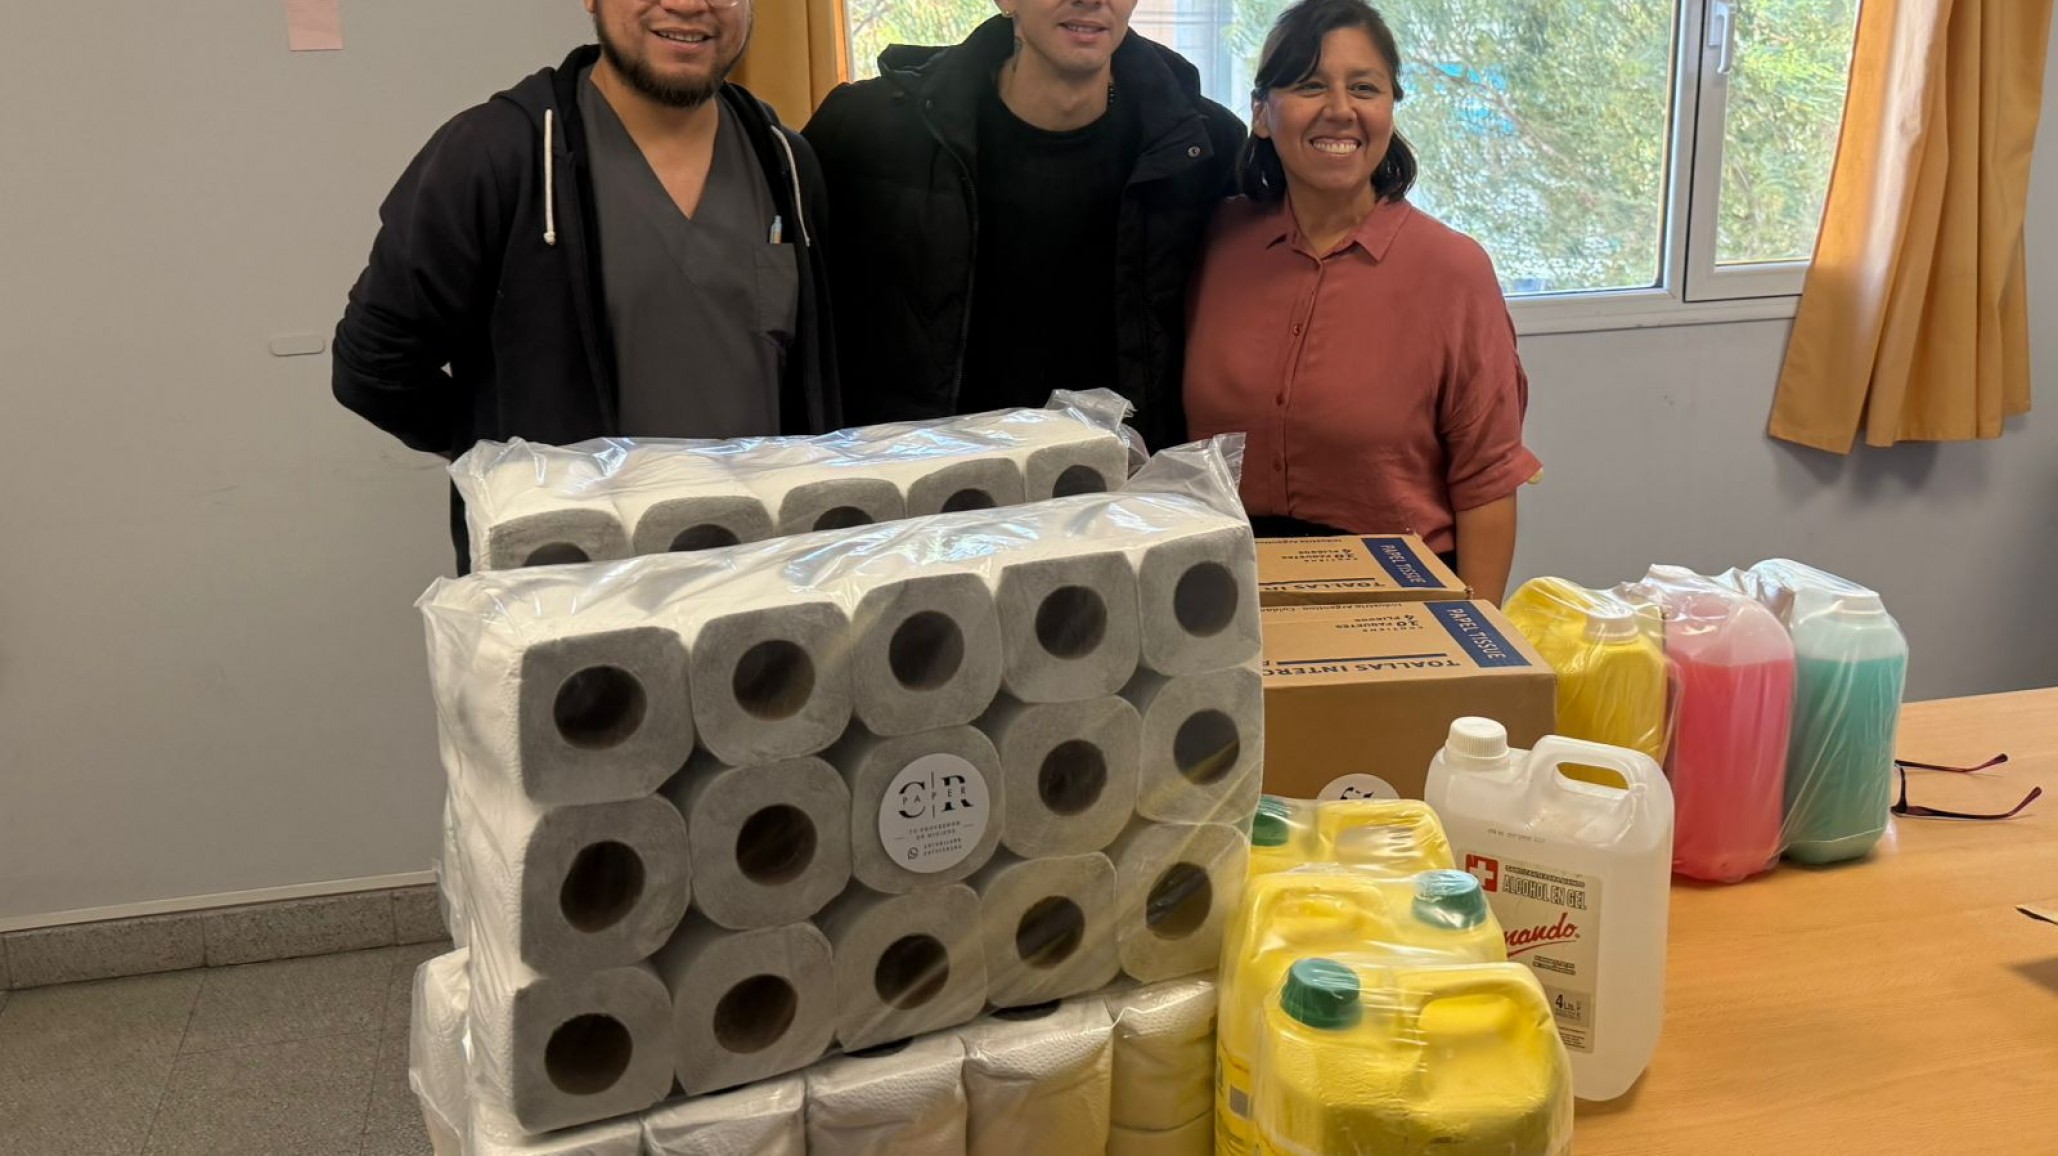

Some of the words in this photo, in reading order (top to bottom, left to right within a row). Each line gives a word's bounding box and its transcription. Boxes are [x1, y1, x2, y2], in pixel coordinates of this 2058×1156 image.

[1380, 544, 1406, 564] PAPEL
[1294, 581, 1386, 589] TOALLAS
[1335, 621, 1393, 629] PAQUETES
[1446, 607, 1480, 633] PAPEL
[1467, 630, 1508, 659] TISSUE
[1354, 659, 1461, 671] TOALLAS
[901, 784, 967, 806] PAPER
[1502, 873, 1550, 902] ALCOHOL
[1550, 885, 1566, 906] EN
[1566, 888, 1588, 911] GEL
